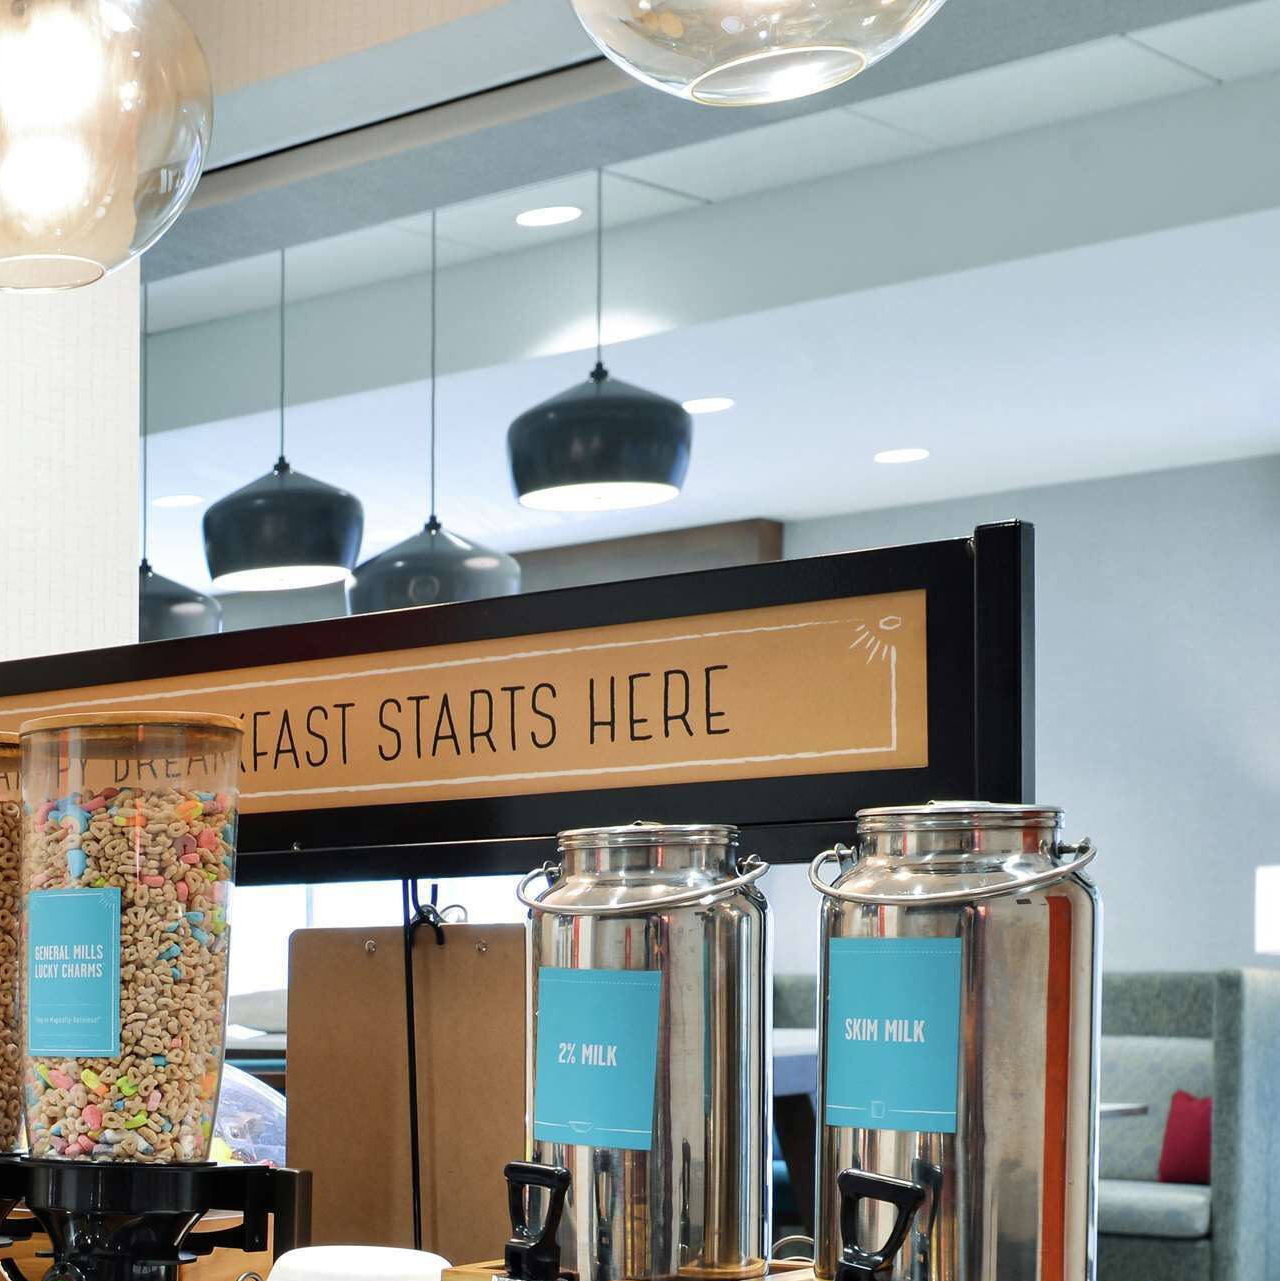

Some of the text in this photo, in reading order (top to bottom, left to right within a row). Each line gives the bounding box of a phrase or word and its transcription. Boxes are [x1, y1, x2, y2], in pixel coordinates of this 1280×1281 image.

[378, 682, 557, 761] STARTS
[589, 664, 731, 745] HERE
[34, 944, 104, 961] GENERAL MILLS
[34, 963, 103, 978] LUCKY CHARMS
[844, 1017, 926, 1044] SKIM MILK
[558, 1043, 618, 1068] 2% MILK
